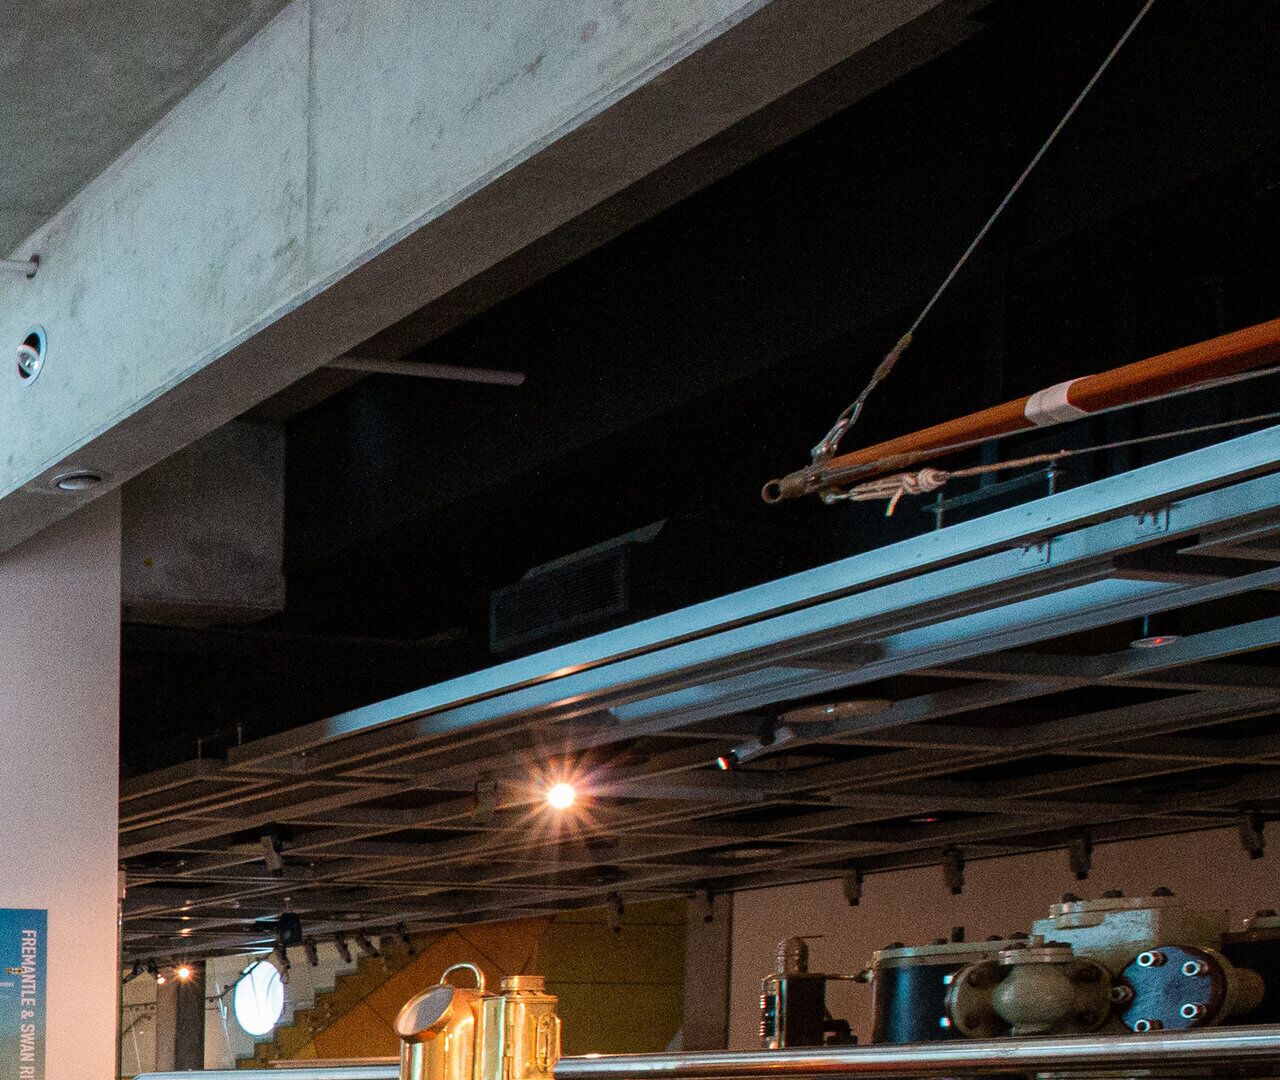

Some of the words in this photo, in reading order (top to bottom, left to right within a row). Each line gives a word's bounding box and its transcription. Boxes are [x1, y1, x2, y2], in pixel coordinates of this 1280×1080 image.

[21, 929, 37, 1006] FREMANTLE
[21, 1010, 35, 1020] &
[20, 1023, 35, 1062] SWAN
